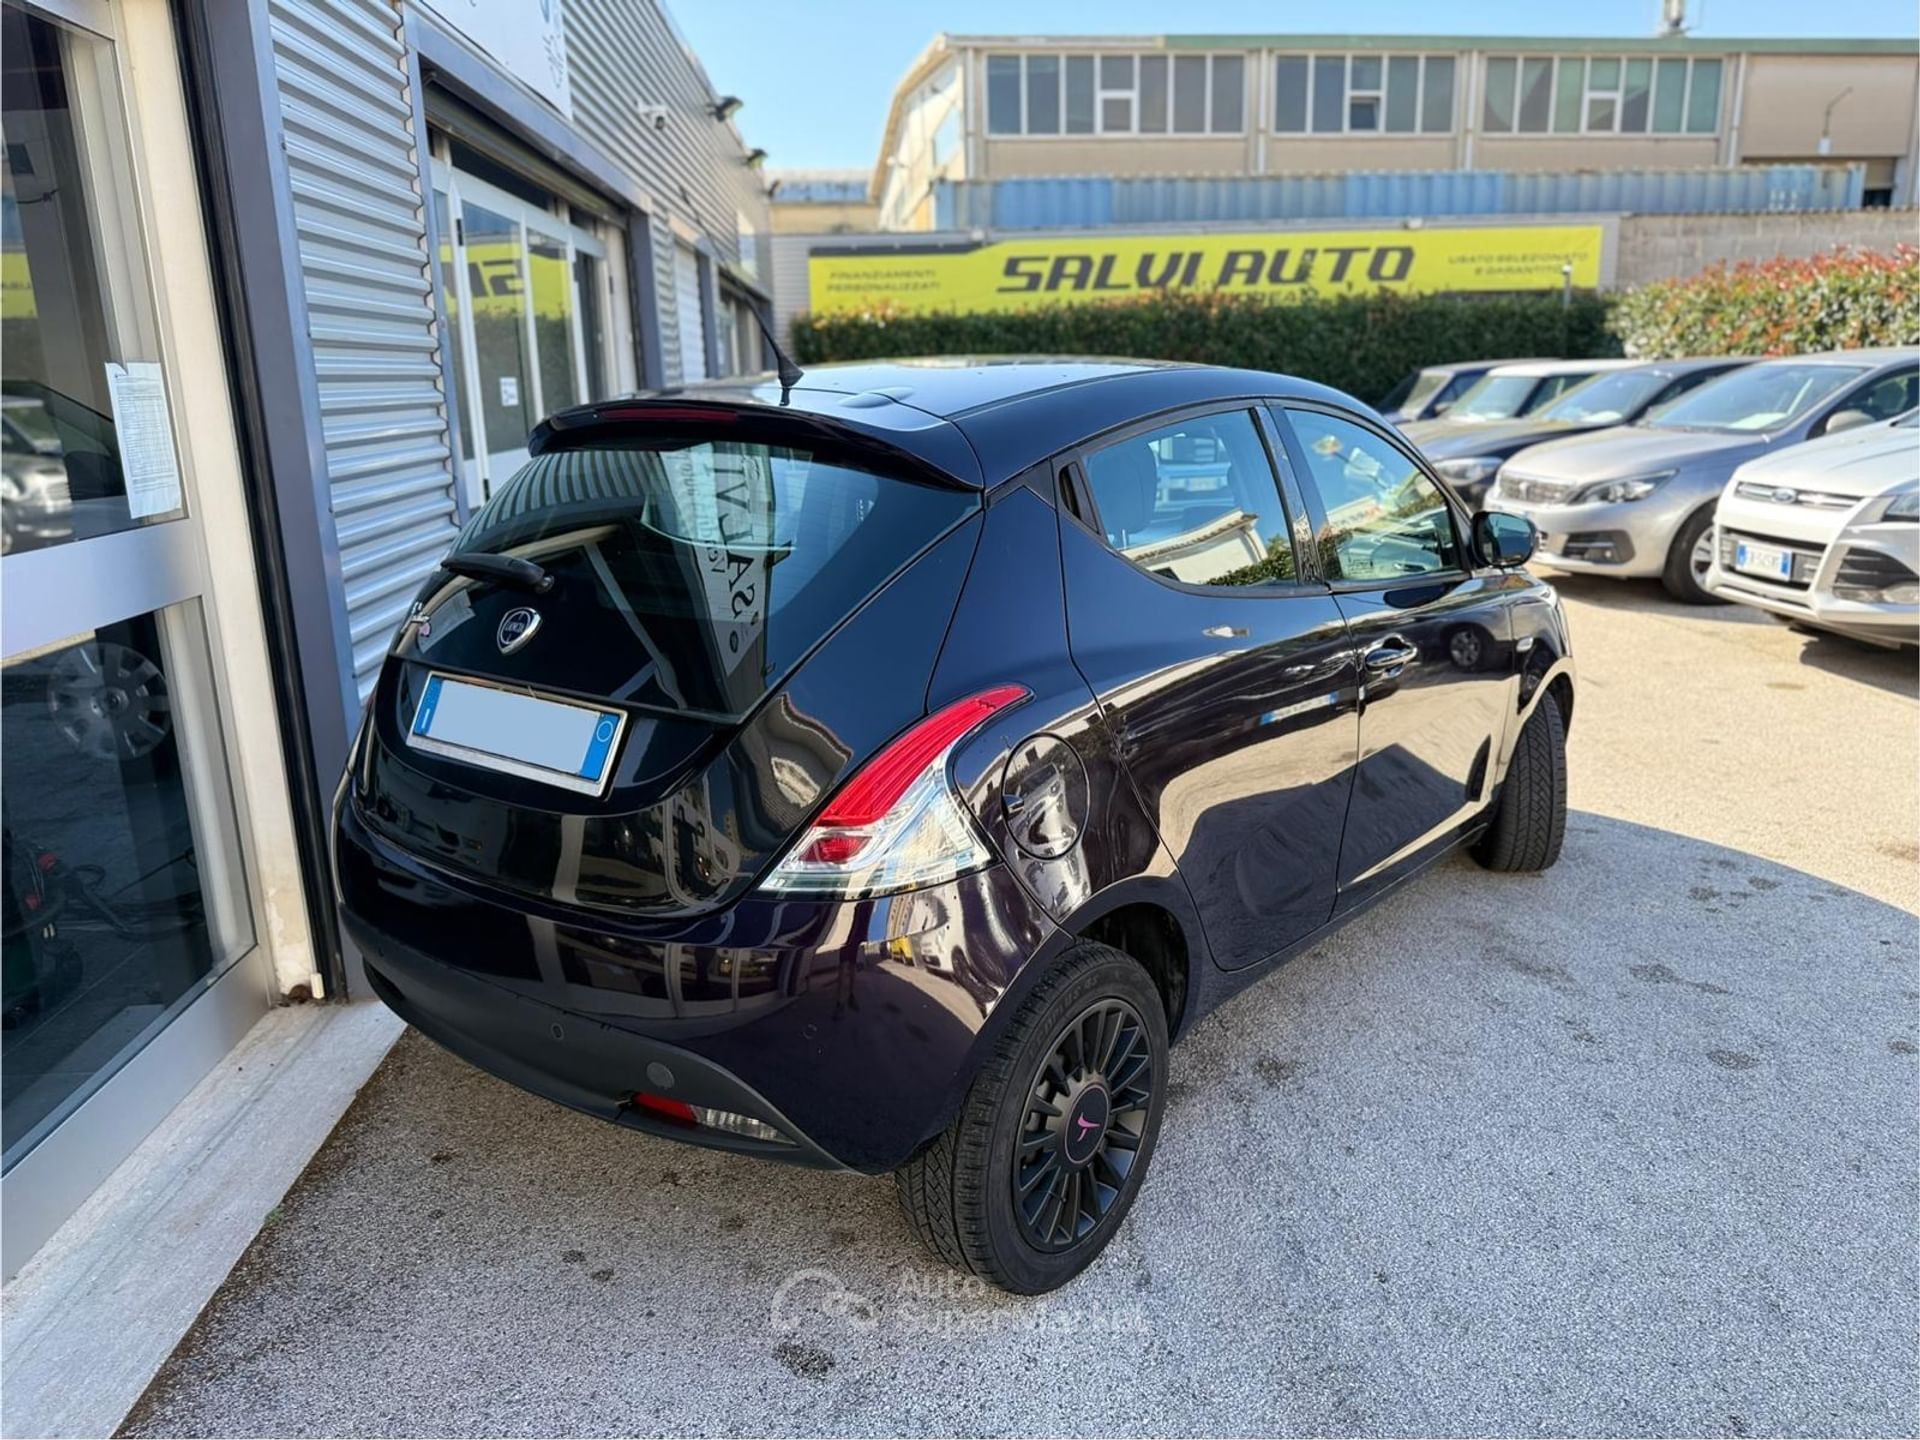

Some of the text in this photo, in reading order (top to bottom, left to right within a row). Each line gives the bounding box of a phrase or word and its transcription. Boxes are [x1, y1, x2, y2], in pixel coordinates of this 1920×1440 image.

[829, 268, 936, 280] FINANZIAMENTI
[996, 246, 1415, 293] SALVI AUTO
[826, 281, 941, 292] PERSONALIZZATI
